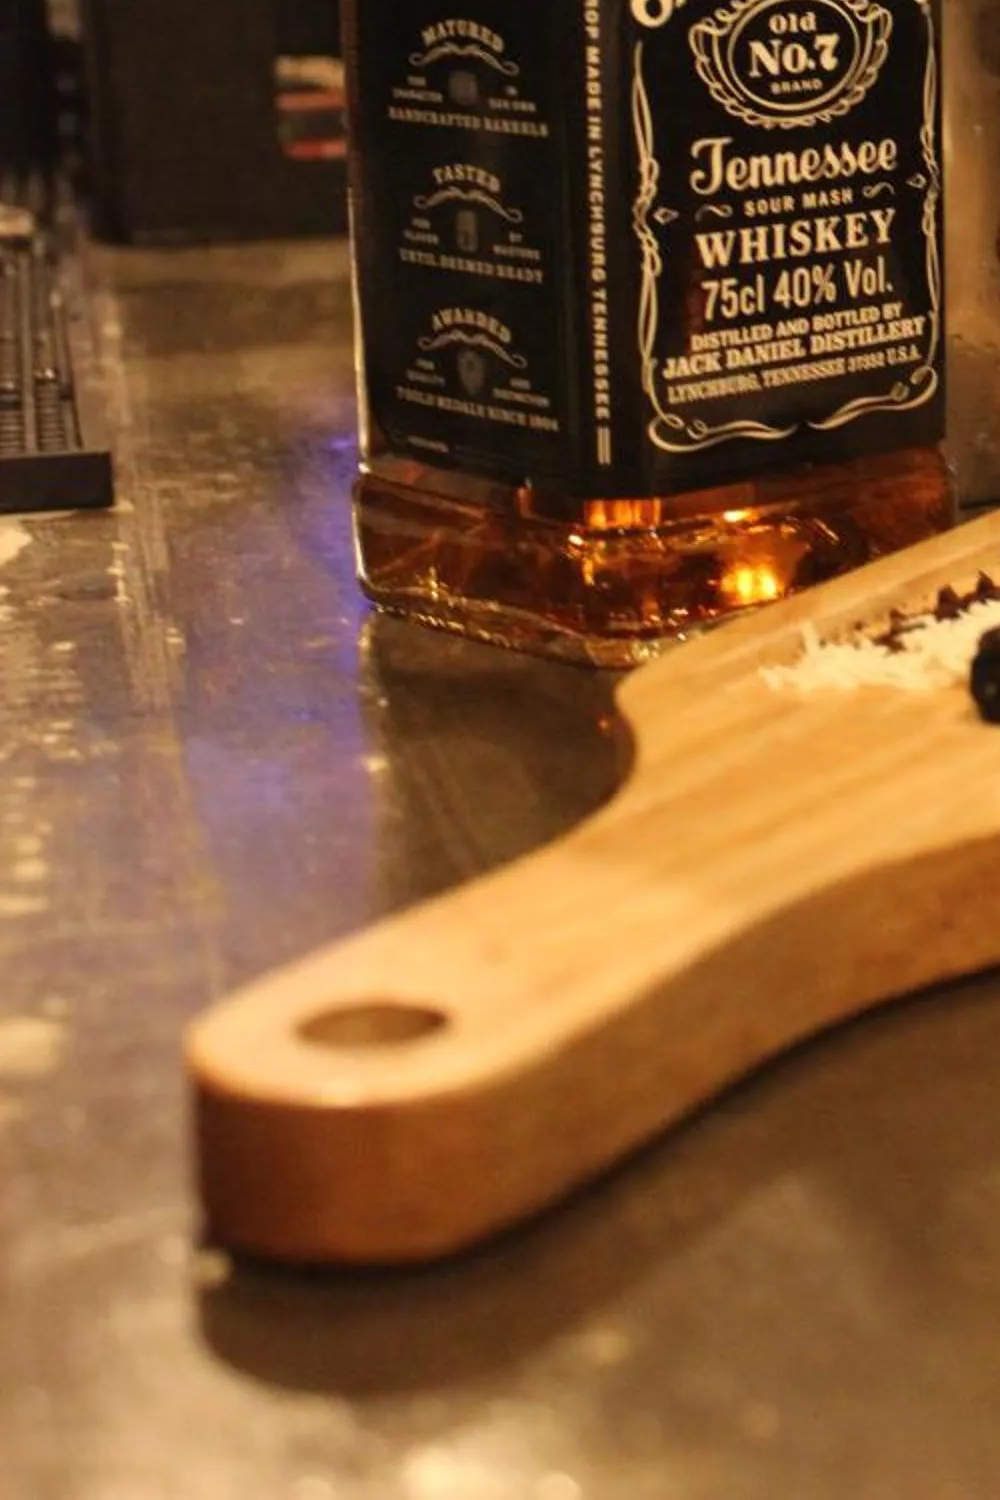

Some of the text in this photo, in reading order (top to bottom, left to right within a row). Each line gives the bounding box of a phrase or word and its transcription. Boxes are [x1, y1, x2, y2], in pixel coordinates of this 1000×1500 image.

[585, 46, 603, 117] MADE
[771, 79, 823, 94] BRAND
[587, 117, 603, 140] IN
[689, 136, 898, 196] Tennessee
[587, 146, 607, 283] LYNCHBURG
[743, 188, 853, 217] SOUR MASH
[695, 208, 896, 269] WHISKEY
[702, 255, 894, 321] 75cl 40% Vol.
[591, 289, 610, 420] TENNESSEE
[663, 315, 927, 380] JACK DANIEL DISTILLERY
[691, 301, 904, 352] DISTILLED AND BOTTLED BY
